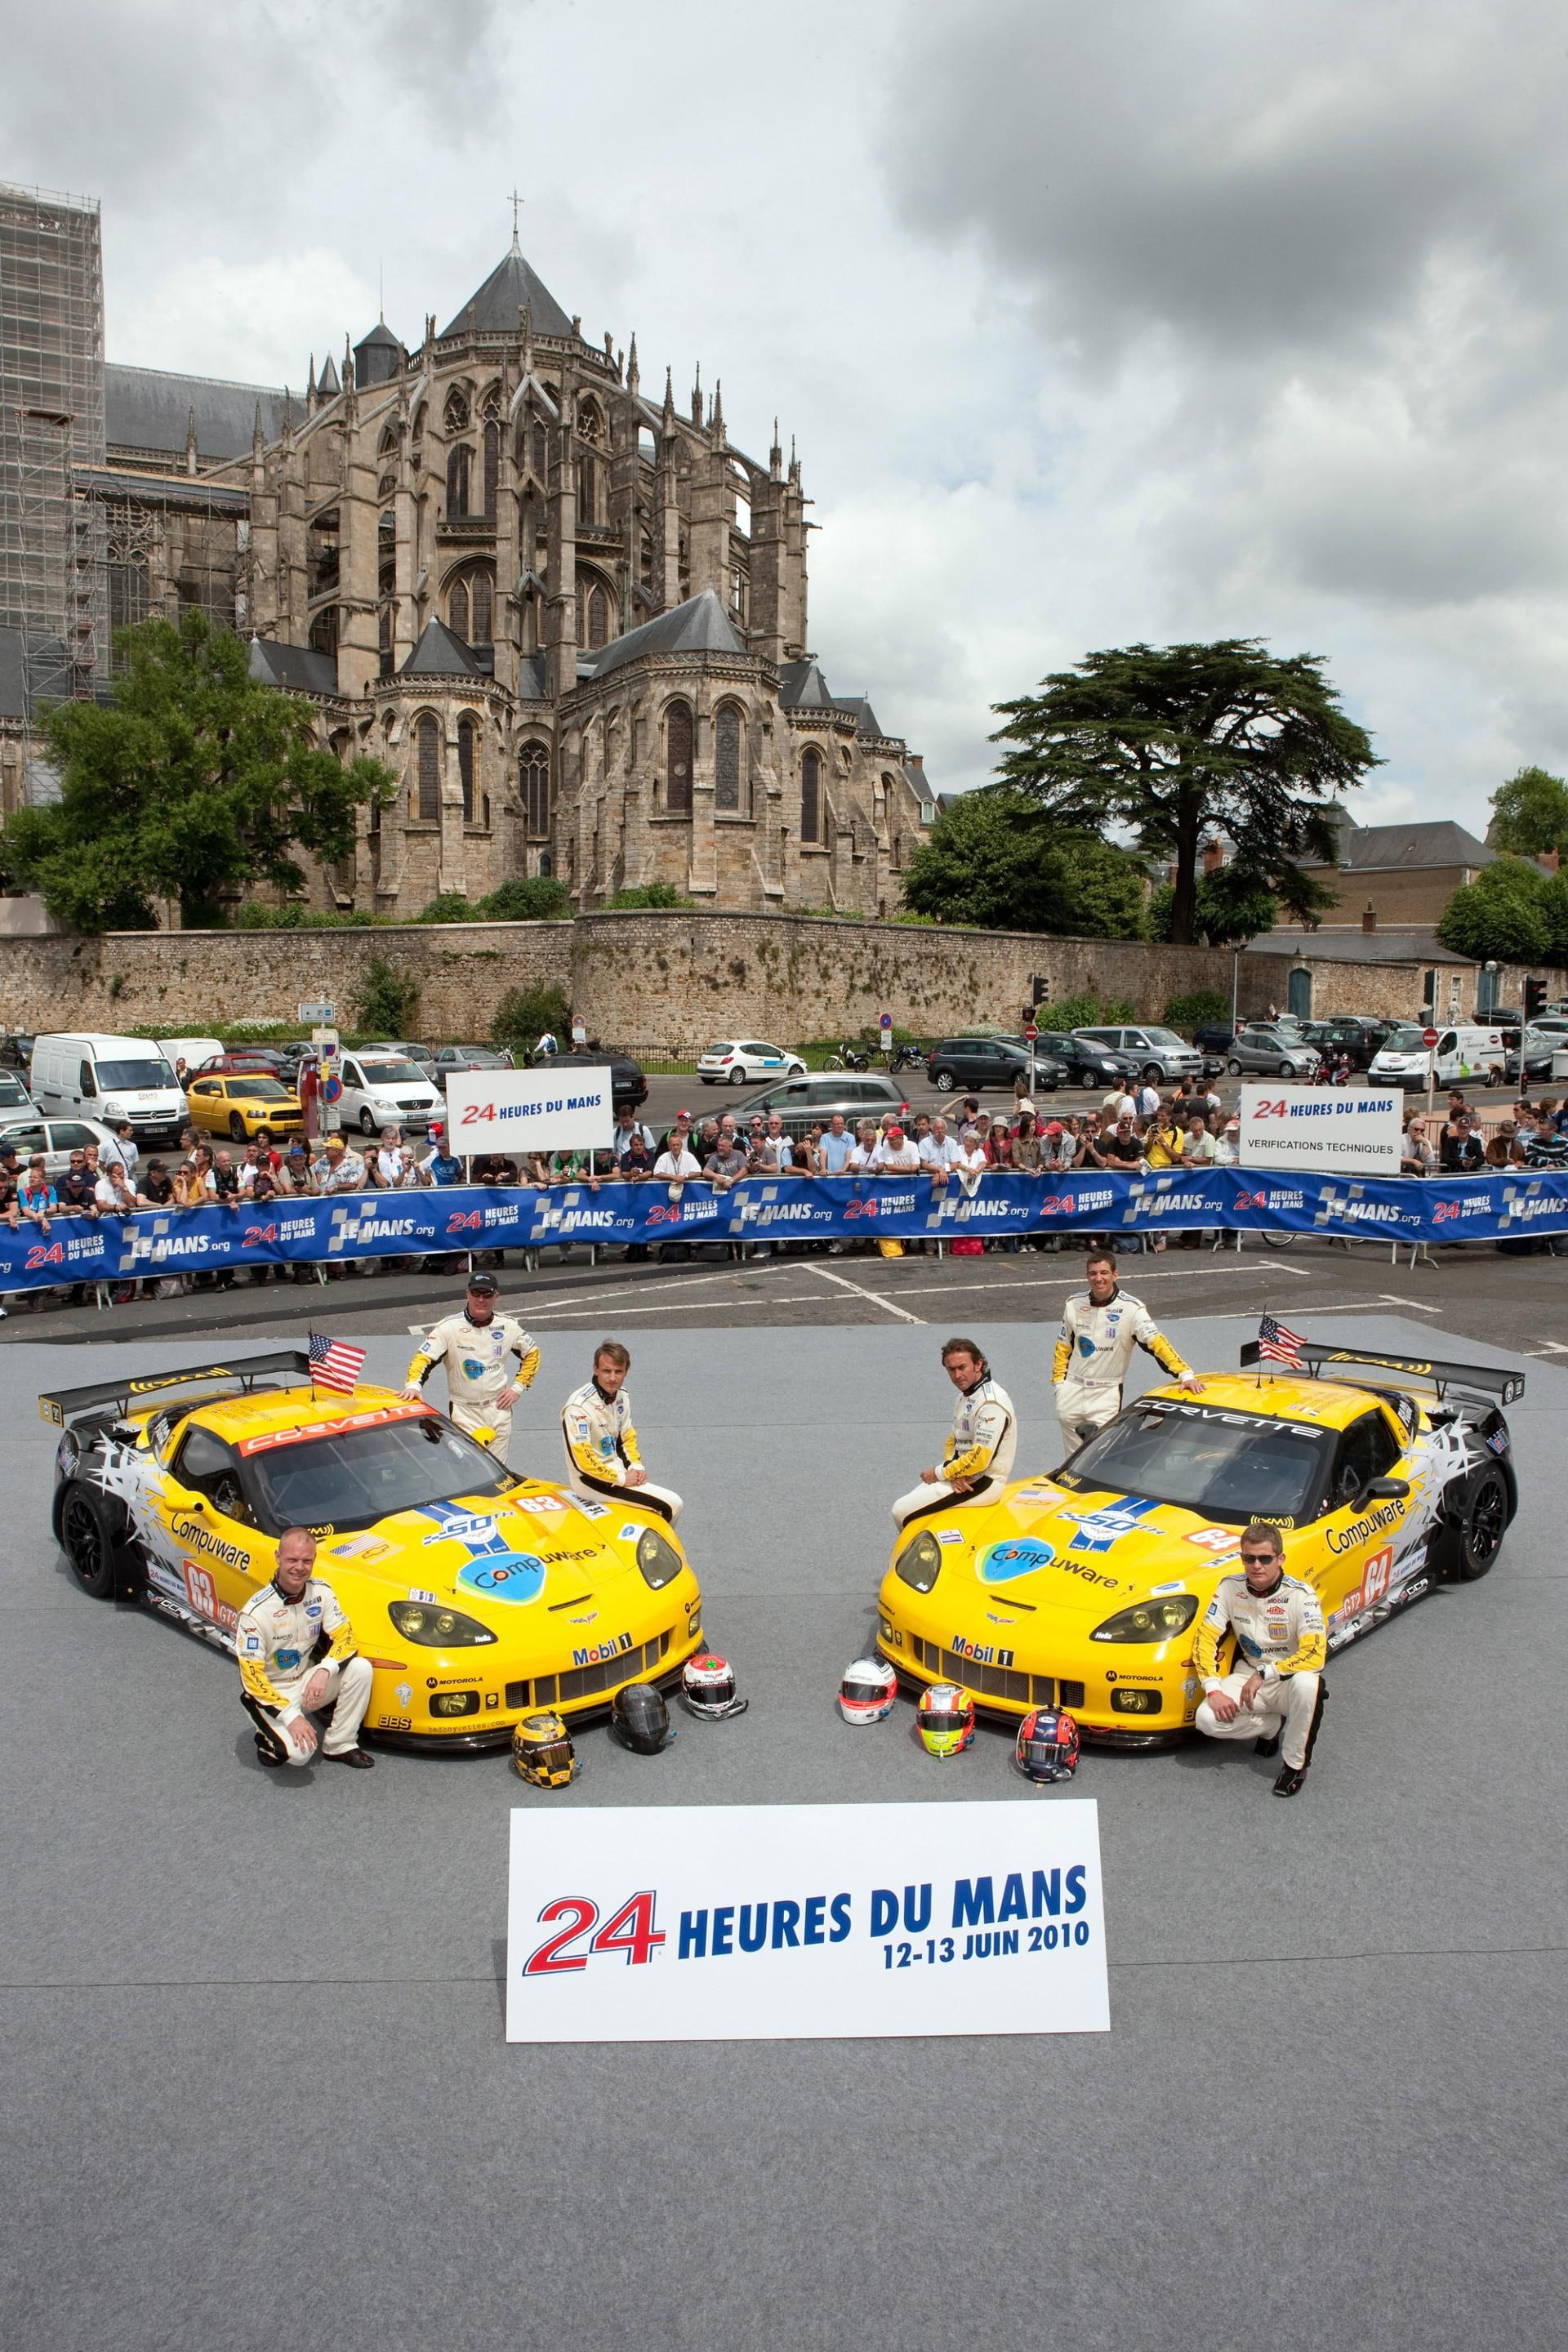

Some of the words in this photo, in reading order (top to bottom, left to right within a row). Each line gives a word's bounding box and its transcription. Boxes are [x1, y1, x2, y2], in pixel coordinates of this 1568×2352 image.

[461, 1103, 497, 1125] 24
[500, 1102, 542, 1120] HEURES
[546, 1100, 563, 1113] DU
[567, 1094, 601, 1110] MANS
[1253, 1099, 1288, 1120] 24
[1290, 1103, 1333, 1116] HEURES
[1336, 1102, 1353, 1114] DU
[1357, 1100, 1393, 1113] MANS
[1248, 1139, 1323, 1151] VERIFICATIONS
[1326, 1143, 1393, 1154] TECHNIQUES
[881, 1194, 915, 1207] HEURES
[1078, 1190, 1113, 1203] HEURES
[1134, 1196, 1151, 1212] LE
[1233, 1191, 1267, 1210] 24
[1270, 1191, 1303, 1200] HEURES
[1463, 1196, 1490, 1208] HEURES
[485, 1205, 519, 1219] HEURES
[684, 1200, 717, 1213] HEURES
[741, 1205, 758, 1220] LE
[844, 1198, 879, 1219] 24
[880, 1207, 892, 1215] DU
[893, 1204, 915, 1214] MANS
[938, 1201, 956, 1217] LE
[1040, 1195, 1076, 1216] 24
[1078, 1203, 1089, 1212] DU
[1091, 1200, 1113, 1210] MANS
[1268, 1200, 1280, 1209] DU
[1281, 1200, 1303, 1209] MANS
[1326, 1200, 1346, 1217] LE
[1432, 1200, 1460, 1224] 24
[1461, 1209, 1471, 1218] DU
[1472, 1205, 1491, 1214] MANS
[1509, 1200, 1525, 1218] LE
[446, 1210, 483, 1234] 24
[485, 1218, 496, 1227] DU
[498, 1215, 519, 1226] MANS
[542, 1212, 559, 1228] LE
[646, 1204, 681, 1225] 24
[684, 1212, 694, 1221] DU
[696, 1209, 718, 1219] MANS
[280, 1218, 314, 1232] HEURES
[340, 1223, 358, 1240] LE
[68, 1235, 104, 1250] HEURES
[242, 1223, 278, 1248] 24
[280, 1232, 292, 1241] DU
[293, 1227, 316, 1239] MANS
[25, 1243, 65, 1269] 24
[68, 1251, 80, 1261] DU
[82, 1245, 105, 1258] MANS
[131, 1241, 151, 1258] LE
[247, 1404, 428, 1451] CORVETTE
[1135, 1399, 1325, 1439] CORVETTE
[517, 1496, 564, 1513] 63
[1326, 1499, 1405, 1554] Compuware
[172, 1512, 251, 1572] Compuware
[1188, 1527, 1241, 1551] 64
[474, 1547, 598, 1589] Compuware
[992, 1548, 1119, 1588] Compuware
[1365, 1553, 1388, 1606] 64
[188, 1566, 214, 1618] 63
[1343, 1592, 1361, 1618] GT2
[220, 1605, 238, 1631] GT2
[573, 1639, 619, 1667] Mobil
[951, 1635, 993, 1663] Mobil
[439, 1677, 483, 1686] MOTOROLA
[1119, 1673, 1164, 1682] MOTOROLA
[378, 1715, 412, 1731] BBS
[428, 1720, 506, 1733] badboyvettes.com
[522, 1889, 666, 1977] 24
[679, 1892, 852, 1959] HEURES
[870, 1883, 932, 1938] DU
[951, 1864, 1087, 1927] MANS
[883, 1937, 956, 1970] 12-13
[962, 1928, 1018, 1961] JUIN
[1027, 1922, 1089, 1952] 2010
